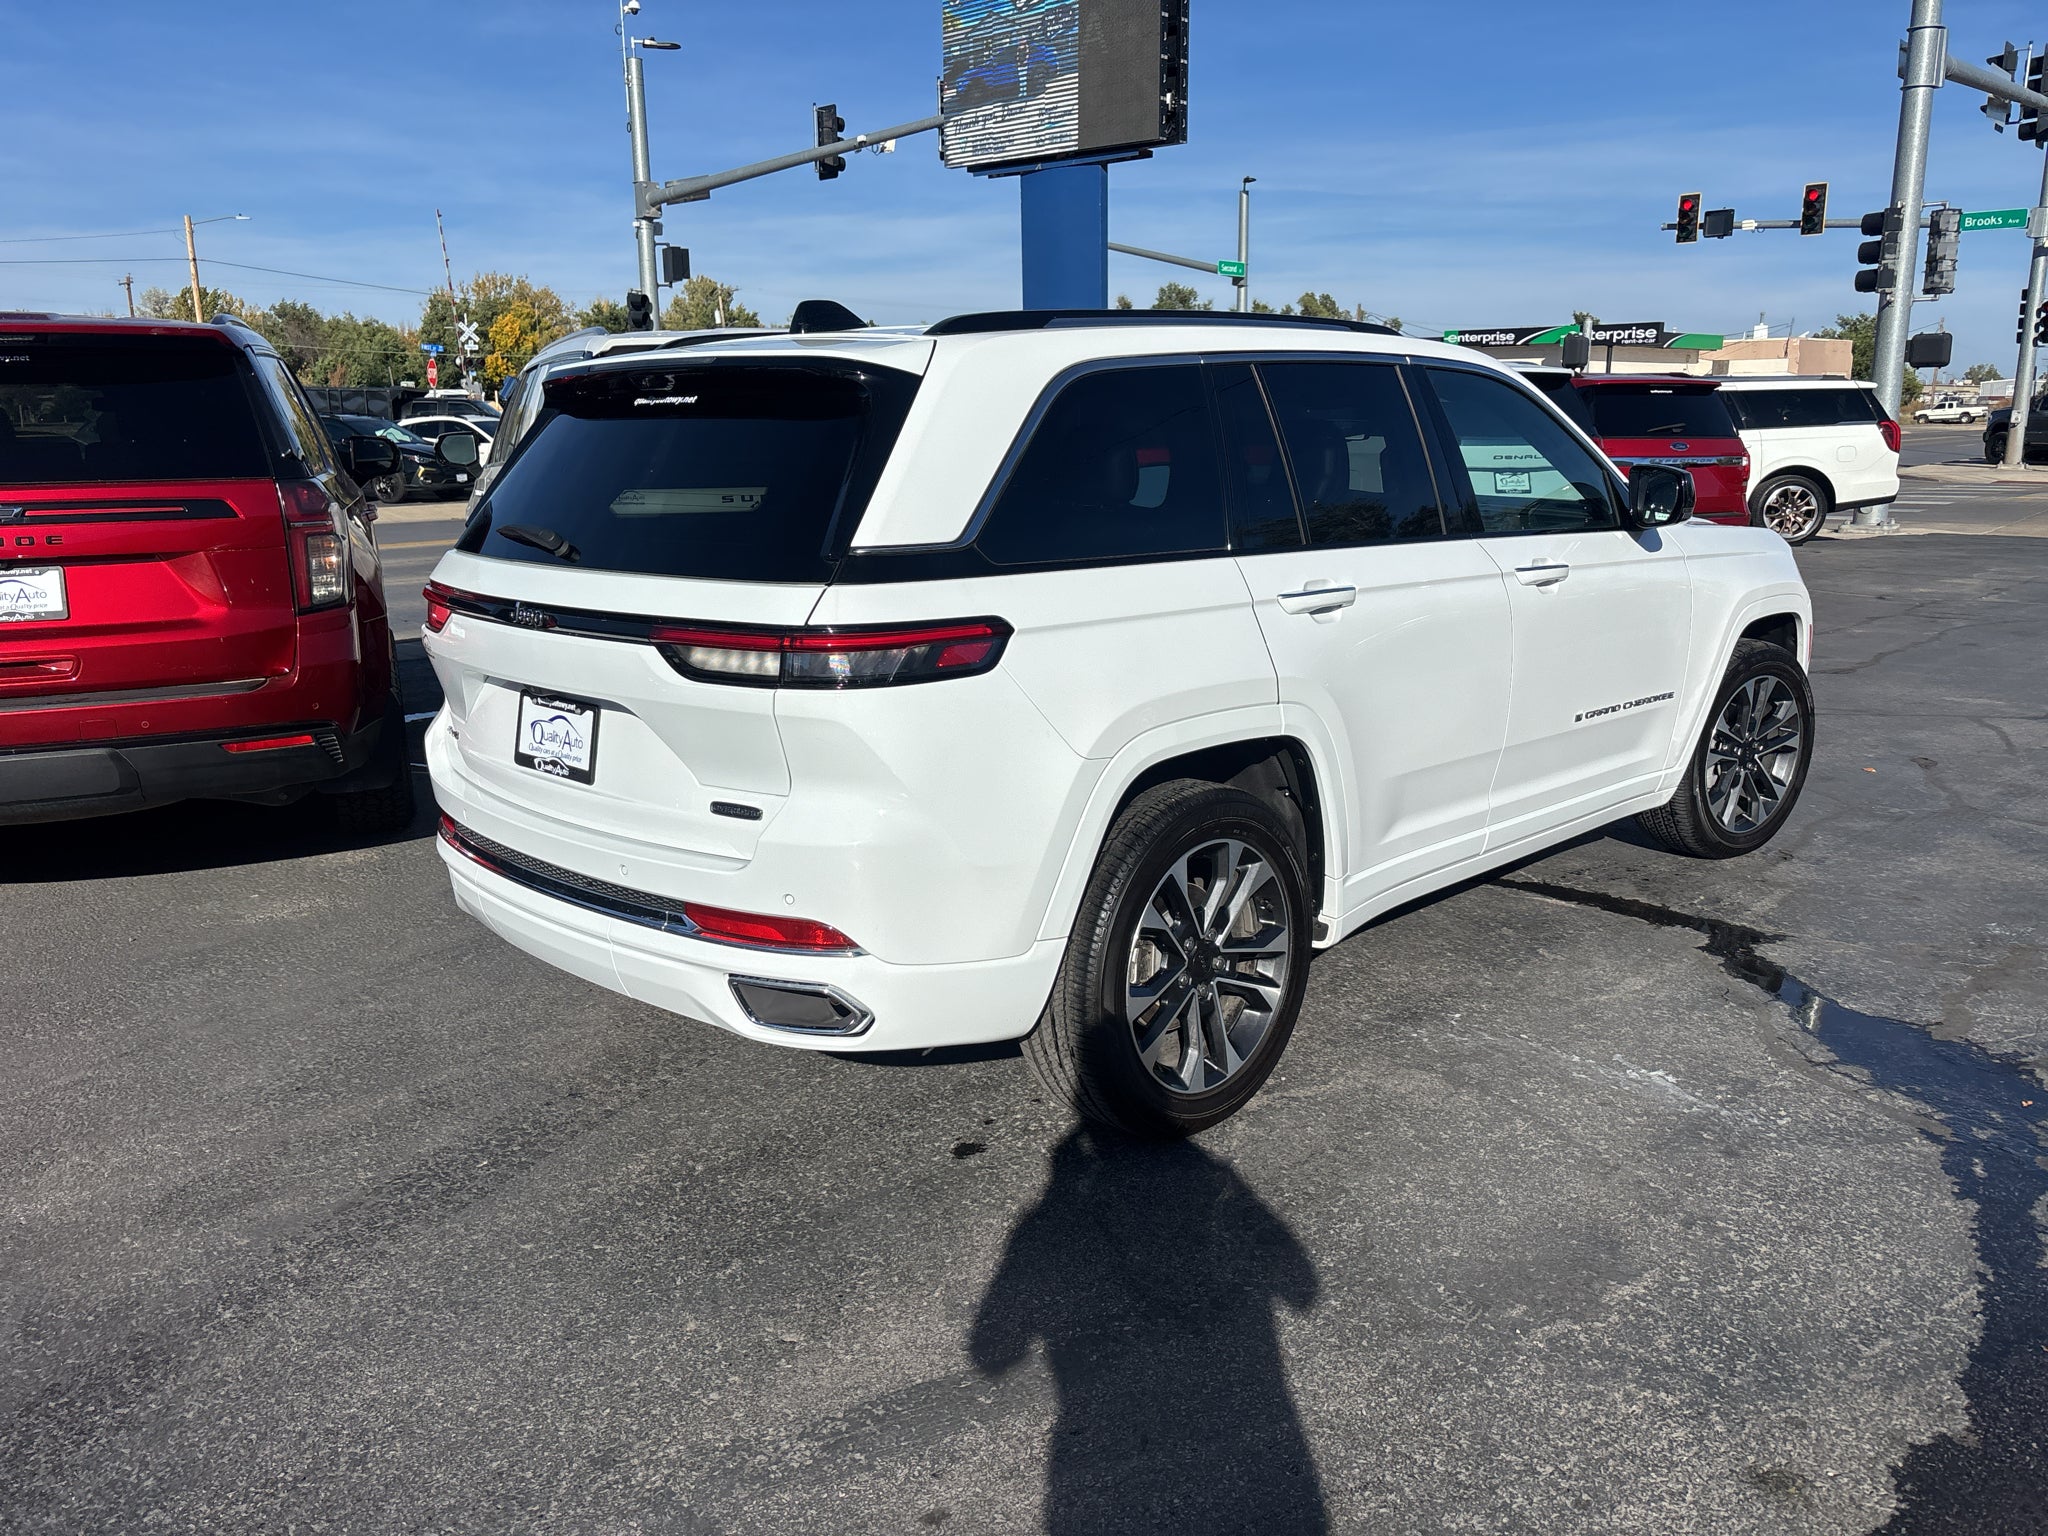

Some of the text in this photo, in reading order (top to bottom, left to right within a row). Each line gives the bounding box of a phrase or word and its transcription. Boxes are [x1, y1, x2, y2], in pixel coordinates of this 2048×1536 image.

[1964, 215, 2003, 227] Brooks
[1443, 331, 1516, 344] enterprise
[1584, 691, 1675, 720] GRAND CHEROKEE
[532, 722, 584, 752] QualityAuto
